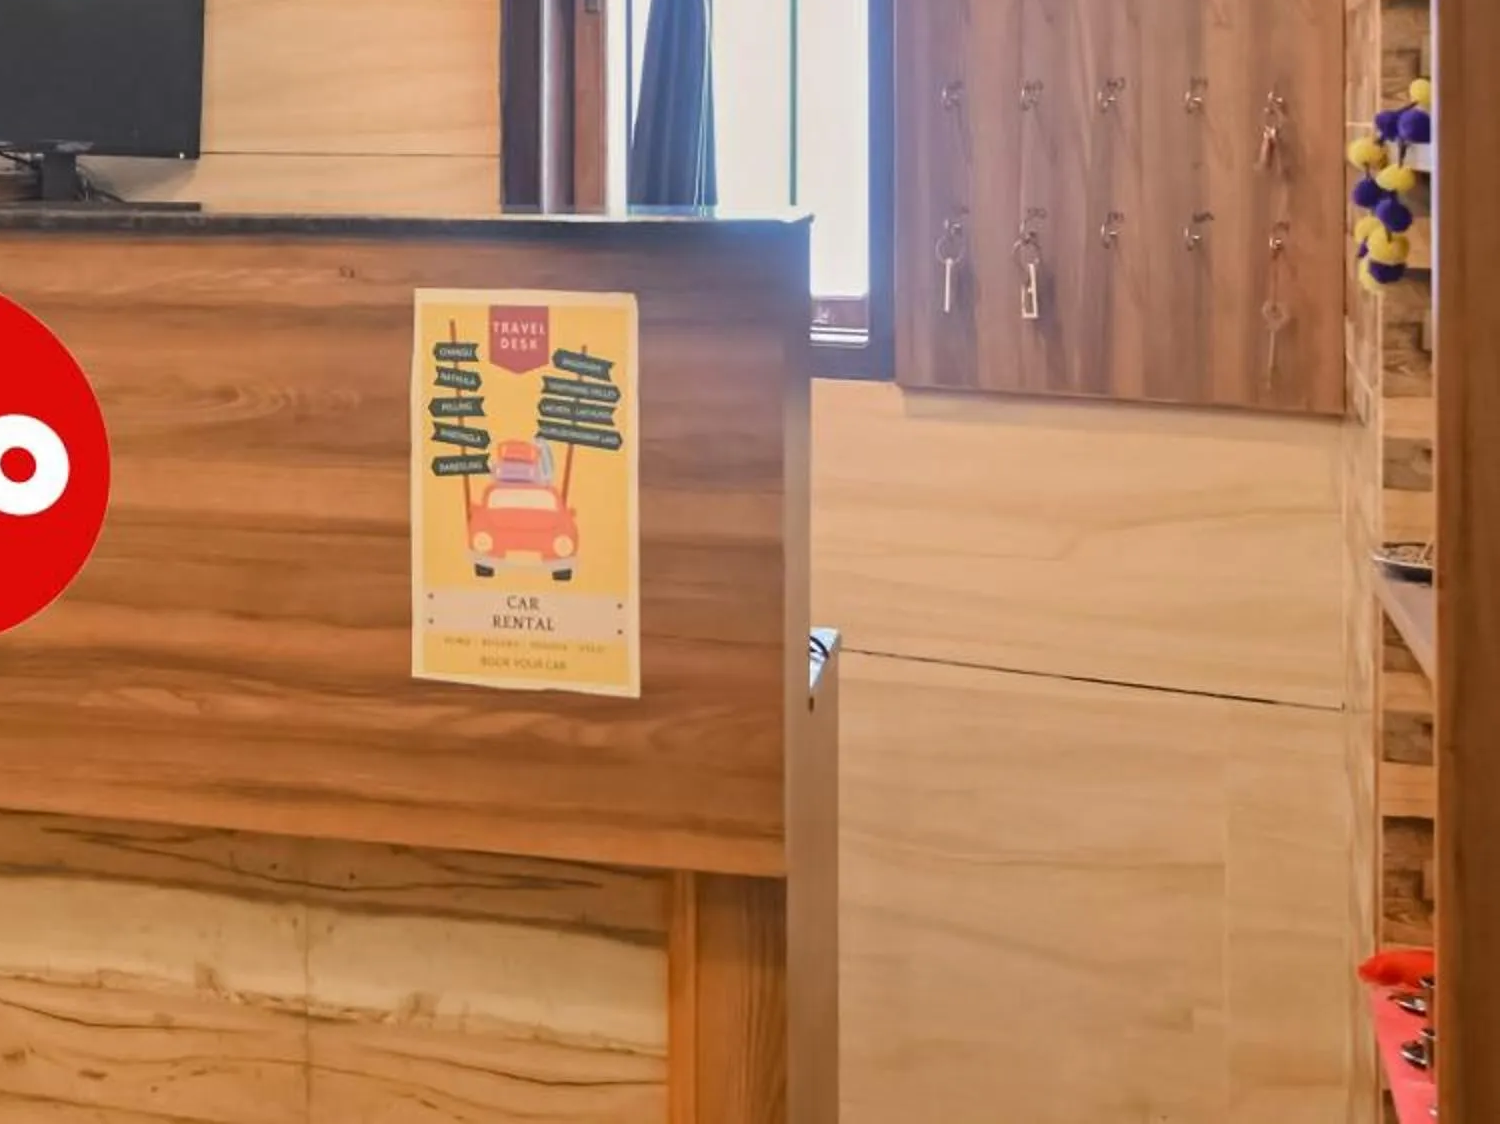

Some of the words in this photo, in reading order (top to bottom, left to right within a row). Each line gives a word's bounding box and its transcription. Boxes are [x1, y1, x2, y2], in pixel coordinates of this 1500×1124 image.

[493, 321, 547, 336] TRAVEL
[501, 337, 539, 351] DESK
[506, 595, 540, 611] CAR
[493, 615, 555, 632] RENTAL
